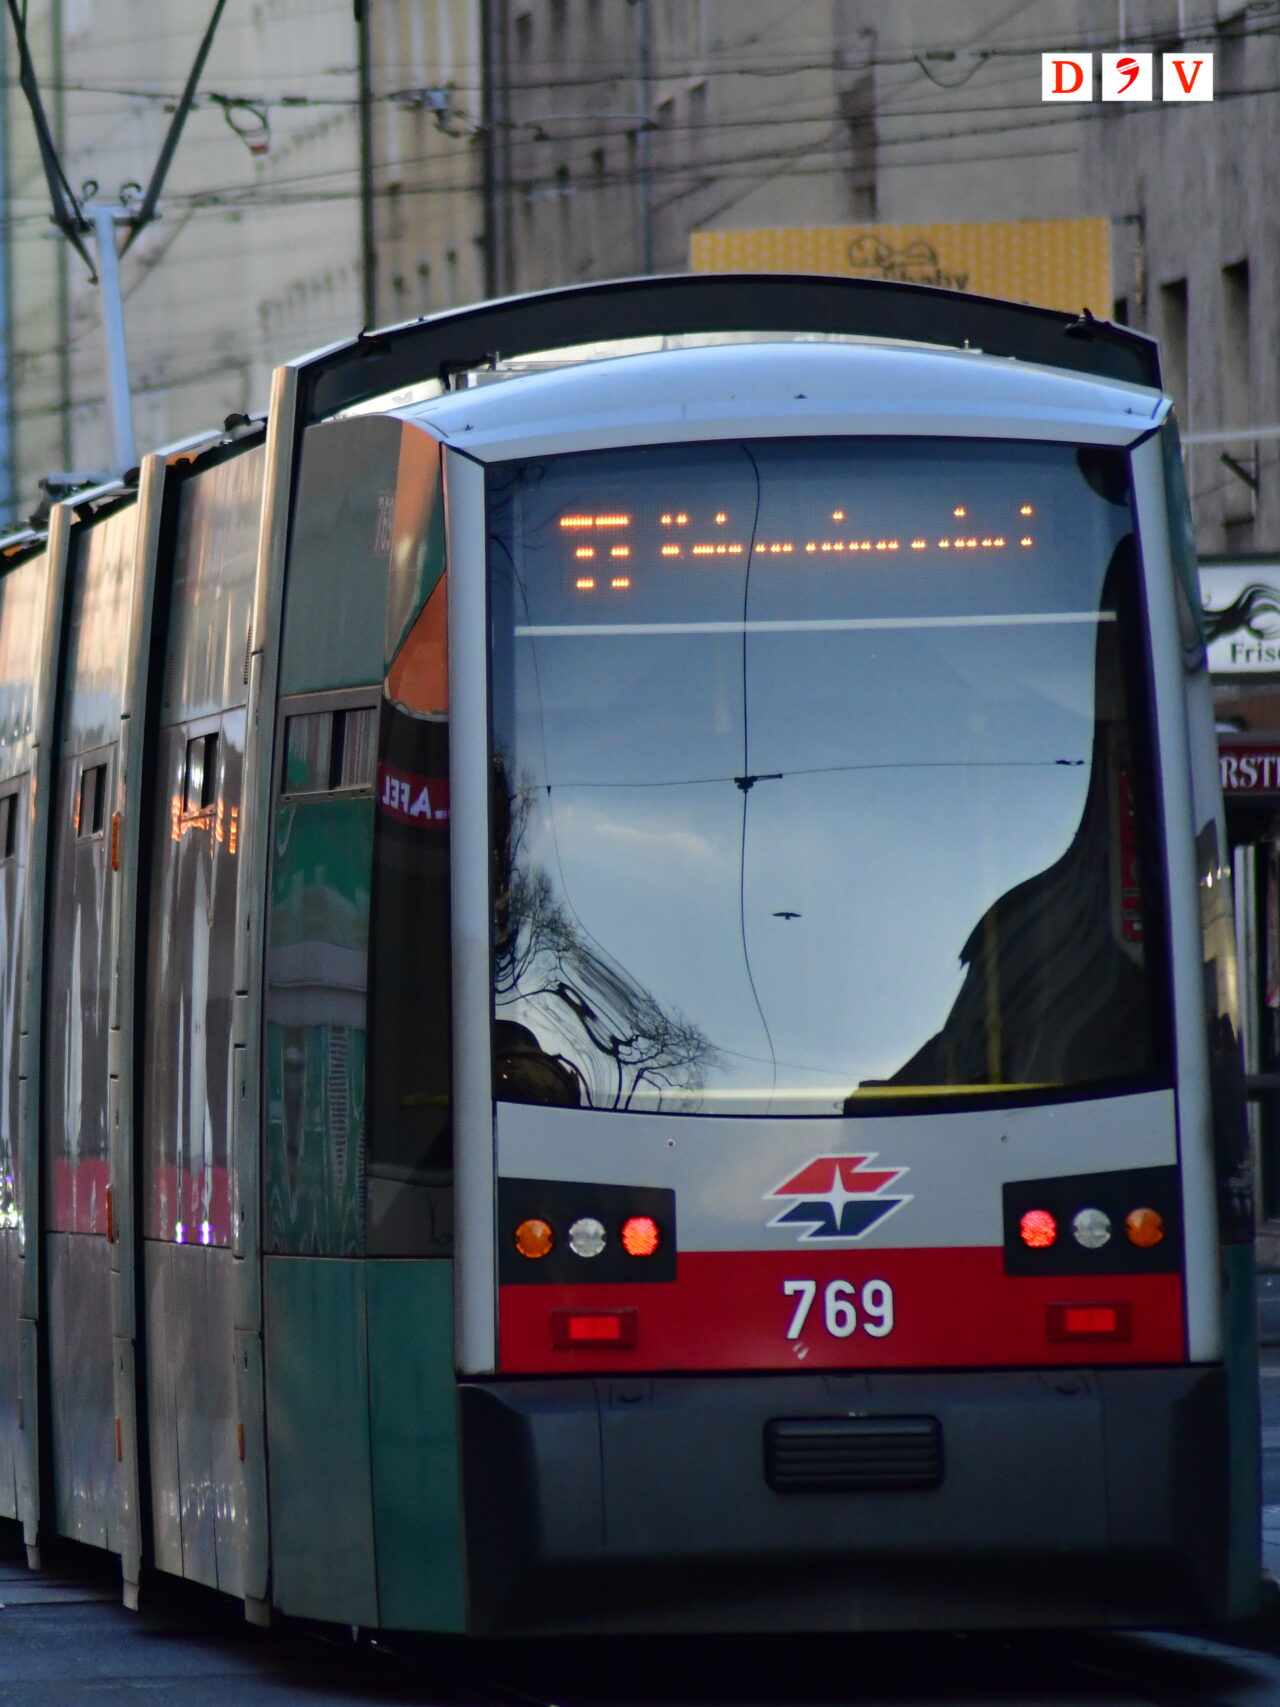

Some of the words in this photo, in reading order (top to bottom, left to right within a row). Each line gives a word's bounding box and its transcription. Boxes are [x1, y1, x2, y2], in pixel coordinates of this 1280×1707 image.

[1231, 642, 1280, 663] Fris
[1220, 756, 1280, 788] RST
[783, 1279, 894, 1339] 769
